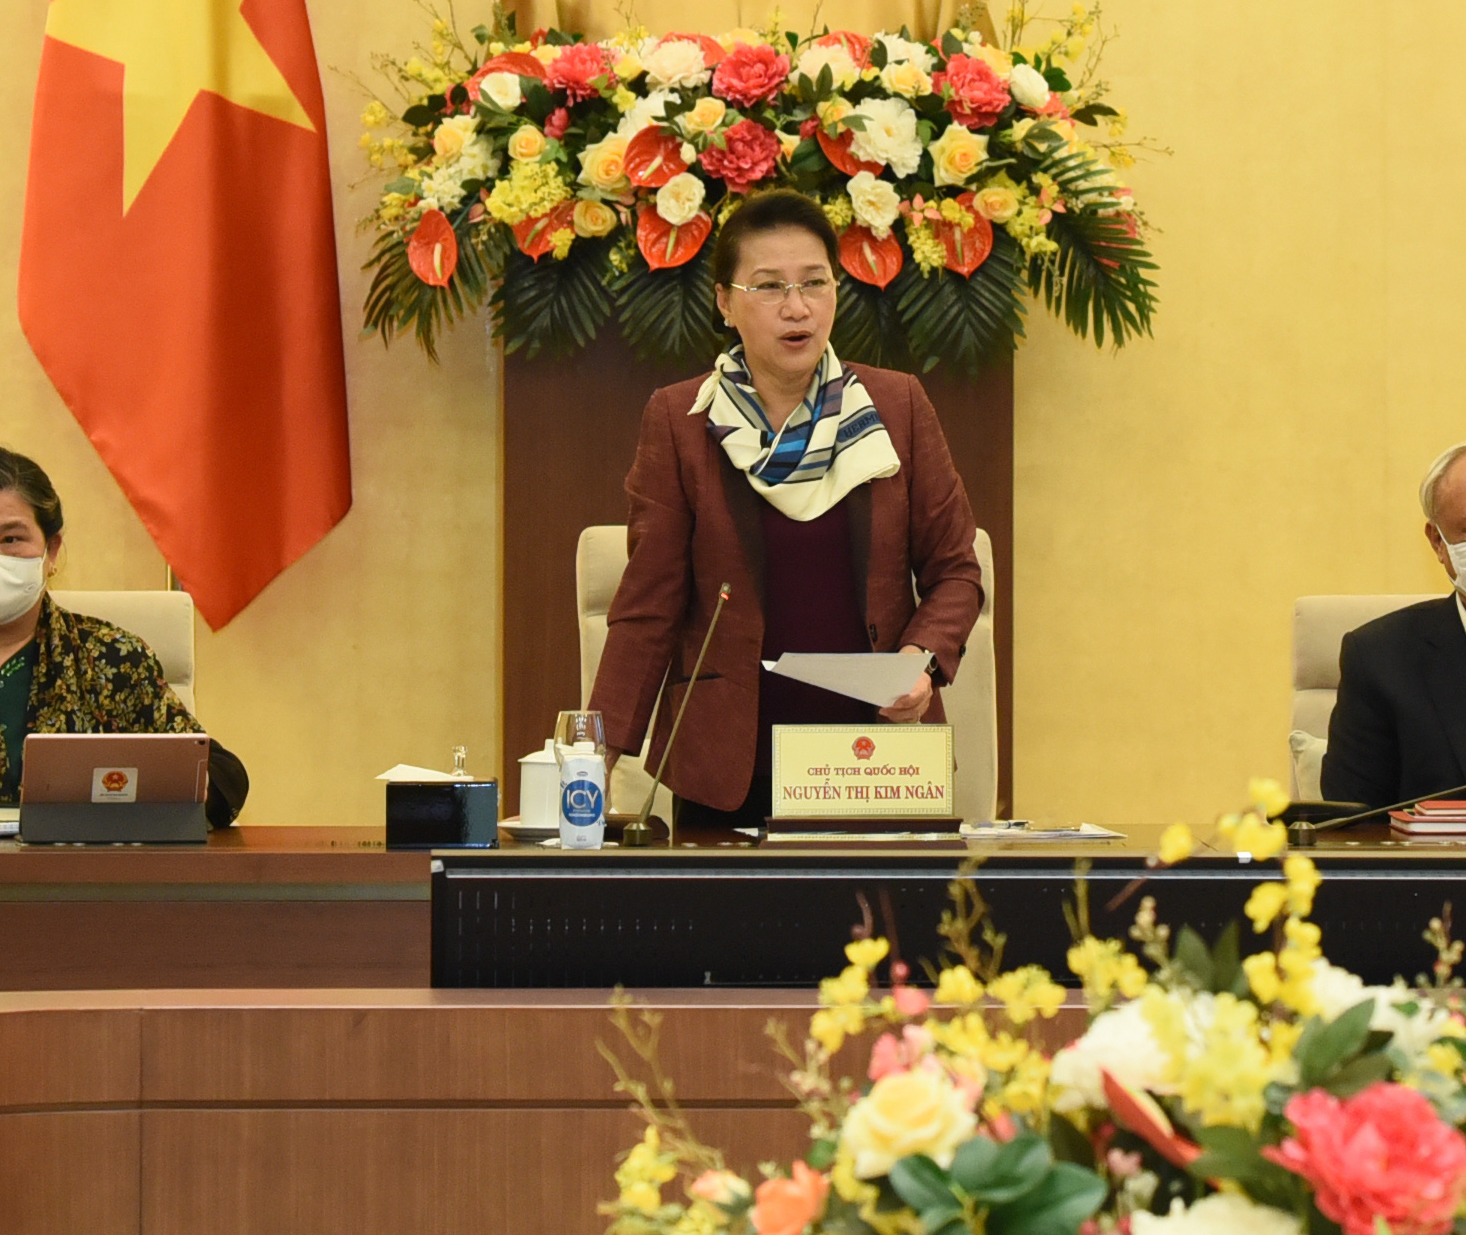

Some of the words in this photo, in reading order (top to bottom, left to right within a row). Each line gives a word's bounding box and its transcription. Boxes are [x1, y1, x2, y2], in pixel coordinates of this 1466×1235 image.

[807, 764, 831, 776] CHỦ
[834, 767, 861, 778] TỊCH
[863, 764, 896, 776] QUỐC
[898, 764, 920, 777] HỘI
[566, 789, 599, 809] ICY
[783, 778, 841, 800] NGUYỄN
[845, 785, 870, 803] THỊ
[873, 785, 901, 799] KIM
[904, 781, 944, 799] NGÂN
